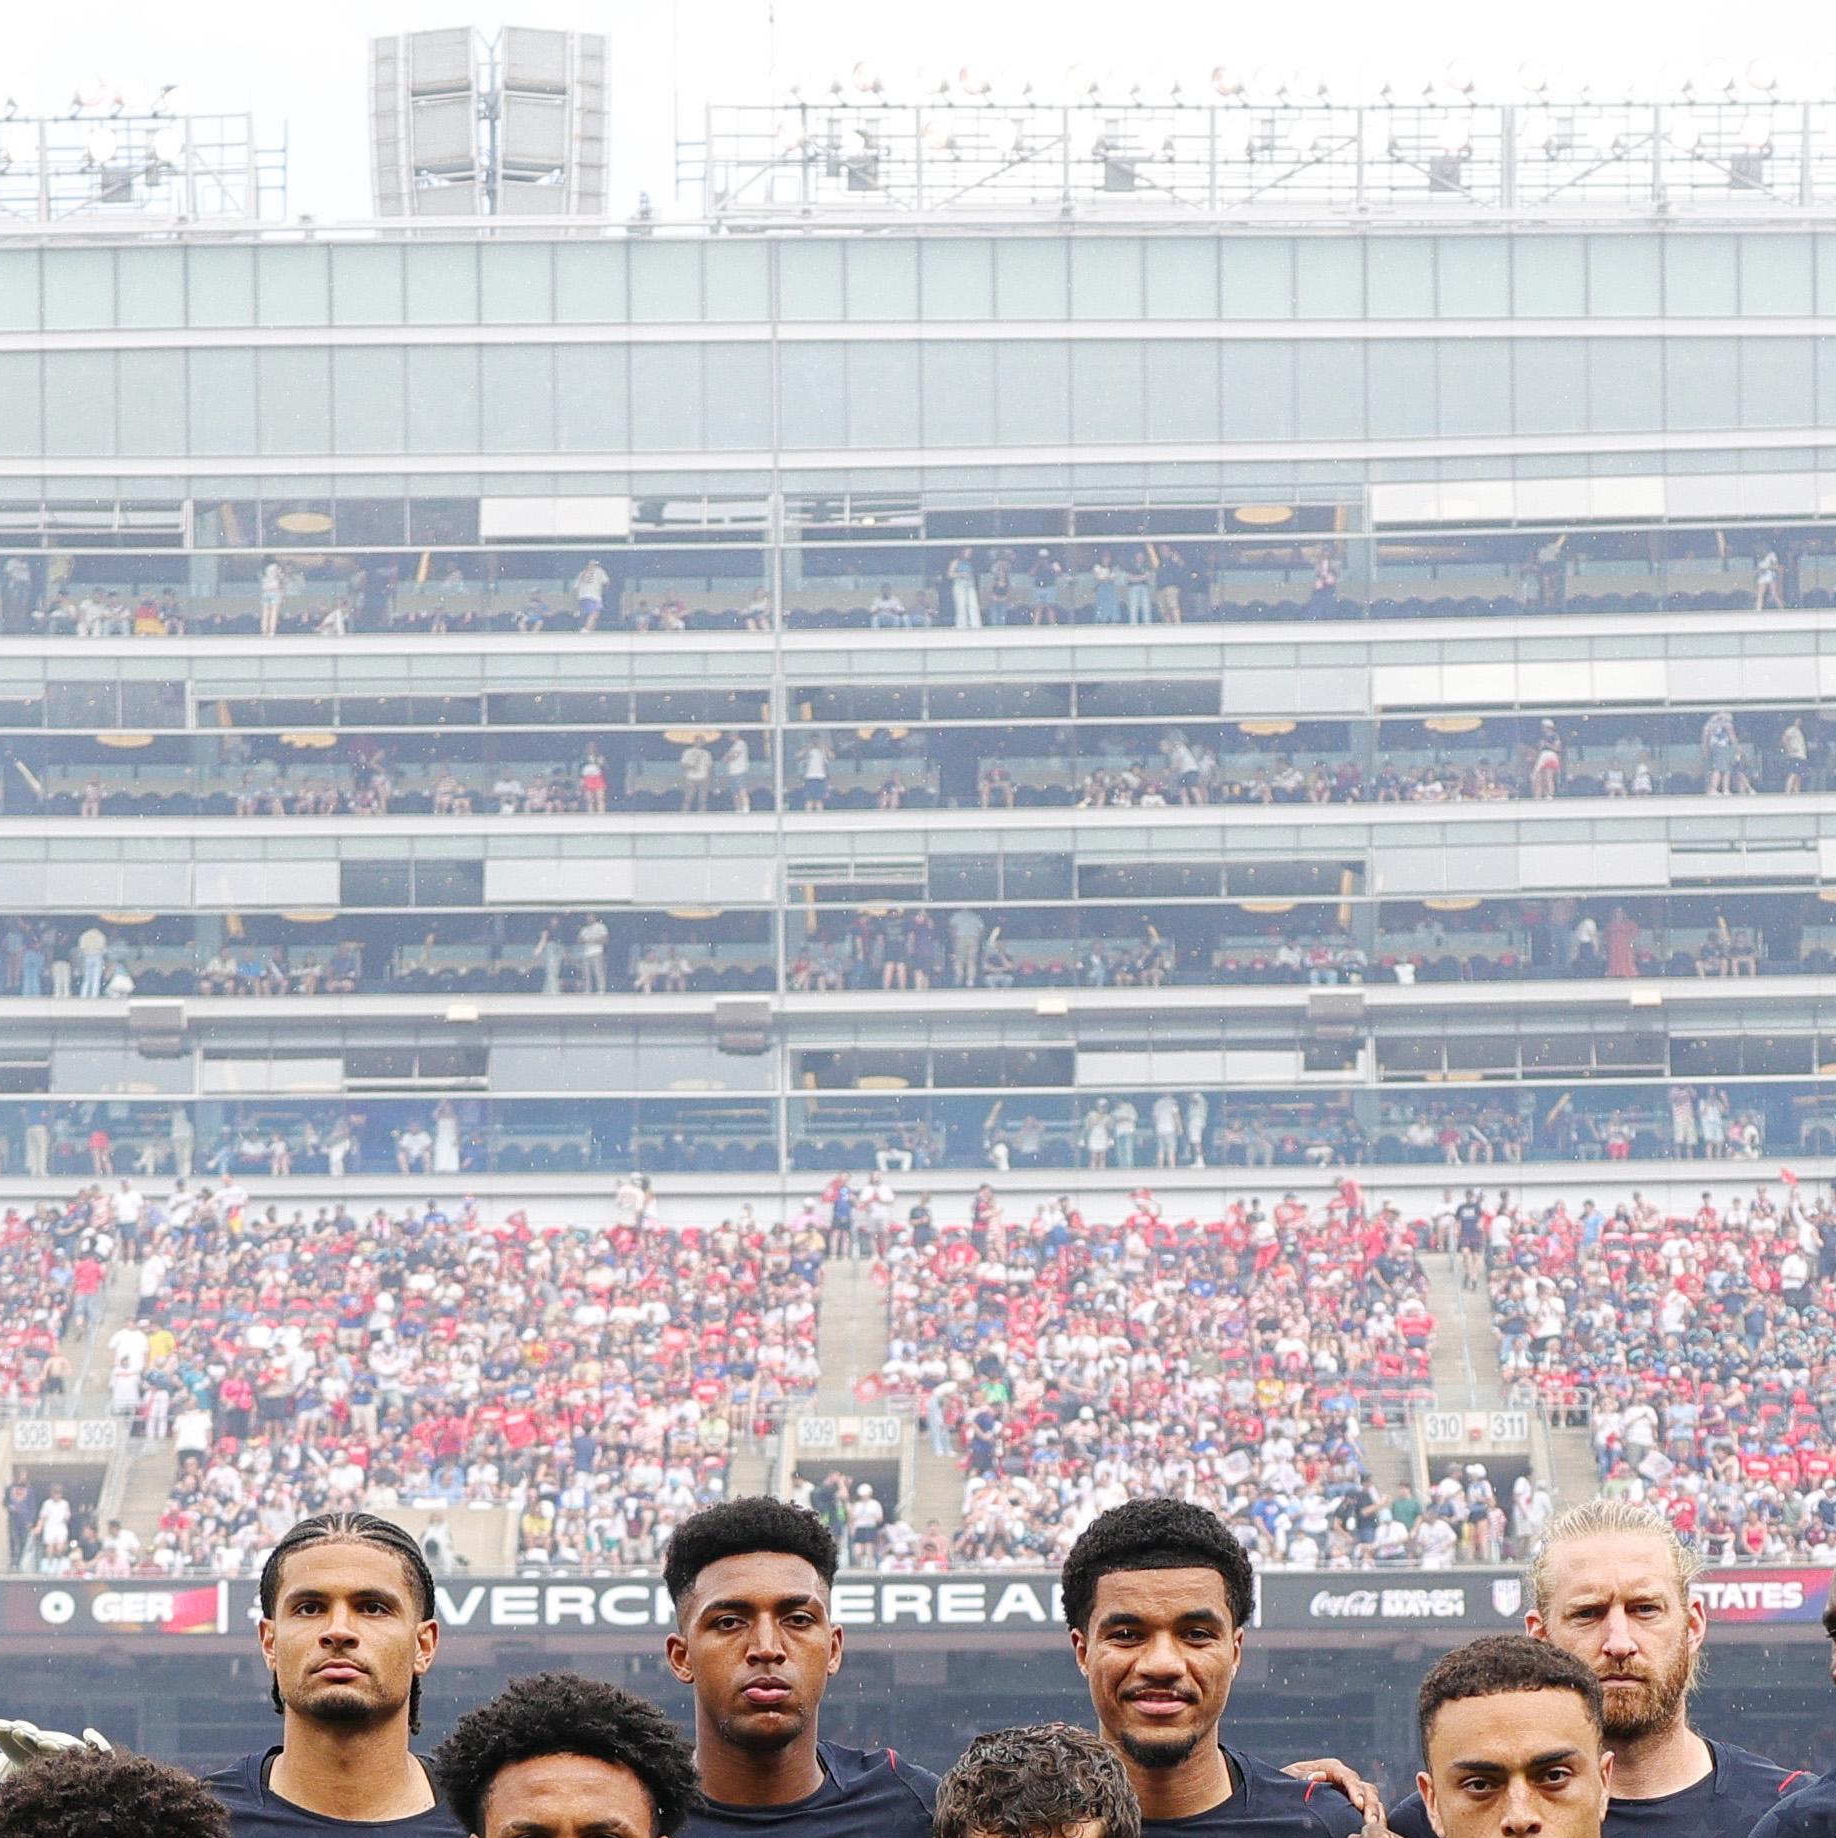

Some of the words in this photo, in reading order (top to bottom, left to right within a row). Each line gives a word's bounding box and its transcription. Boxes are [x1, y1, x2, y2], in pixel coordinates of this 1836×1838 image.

[867, 1420, 897, 1441] 310
[1429, 1417, 1459, 1437] 310
[1493, 1416, 1524, 1437] 311
[92, 1592, 174, 1623] GER
[1382, 1599, 1466, 1617] MATCH
